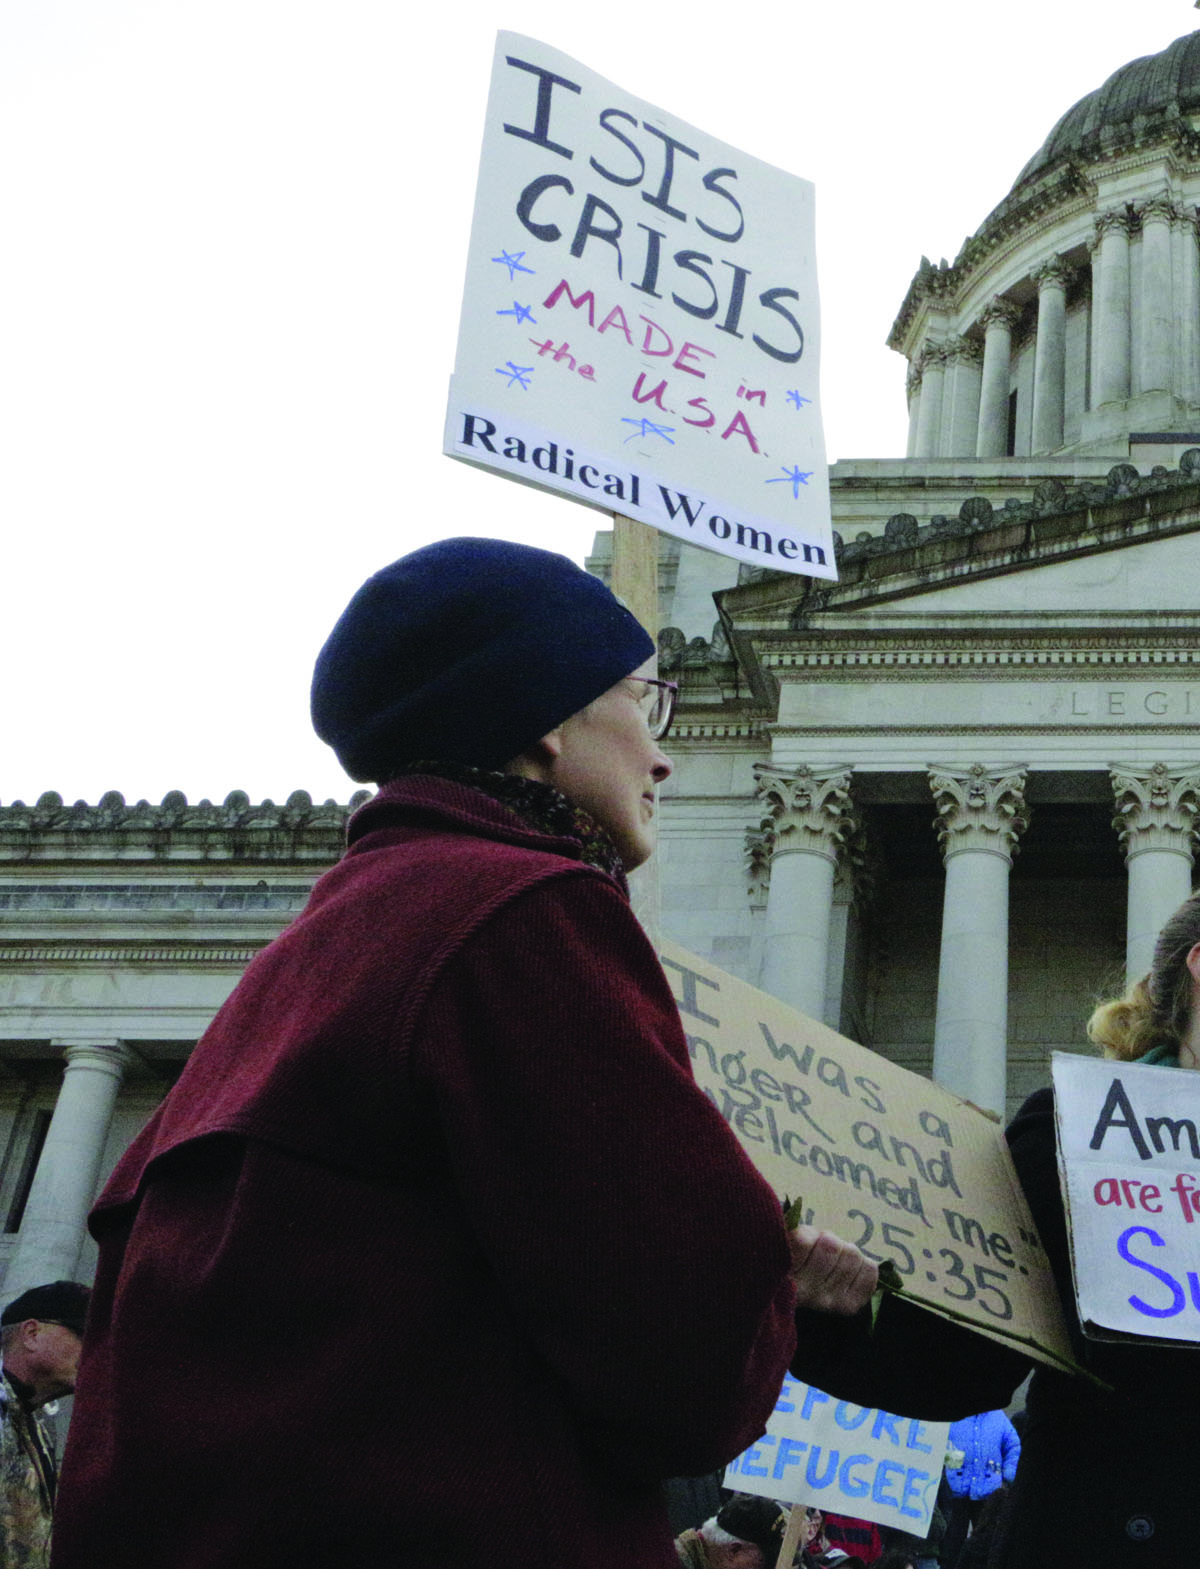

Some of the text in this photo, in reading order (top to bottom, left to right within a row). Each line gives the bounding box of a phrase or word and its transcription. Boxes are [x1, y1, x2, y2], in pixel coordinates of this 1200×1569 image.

[502, 55, 745, 243] ISIS
[515, 174, 804, 363] CRISIS
[529, 337, 597, 382] the
[542, 279, 767, 407] MADE in
[460, 412, 827, 566] Radical Women
[661, 955, 720, 1028] I
[919, 1110, 953, 1147] a
[852, 1120, 962, 1199] and
[1094, 1177, 1162, 1214] are
[848, 1209, 1012, 1320] 25:35
